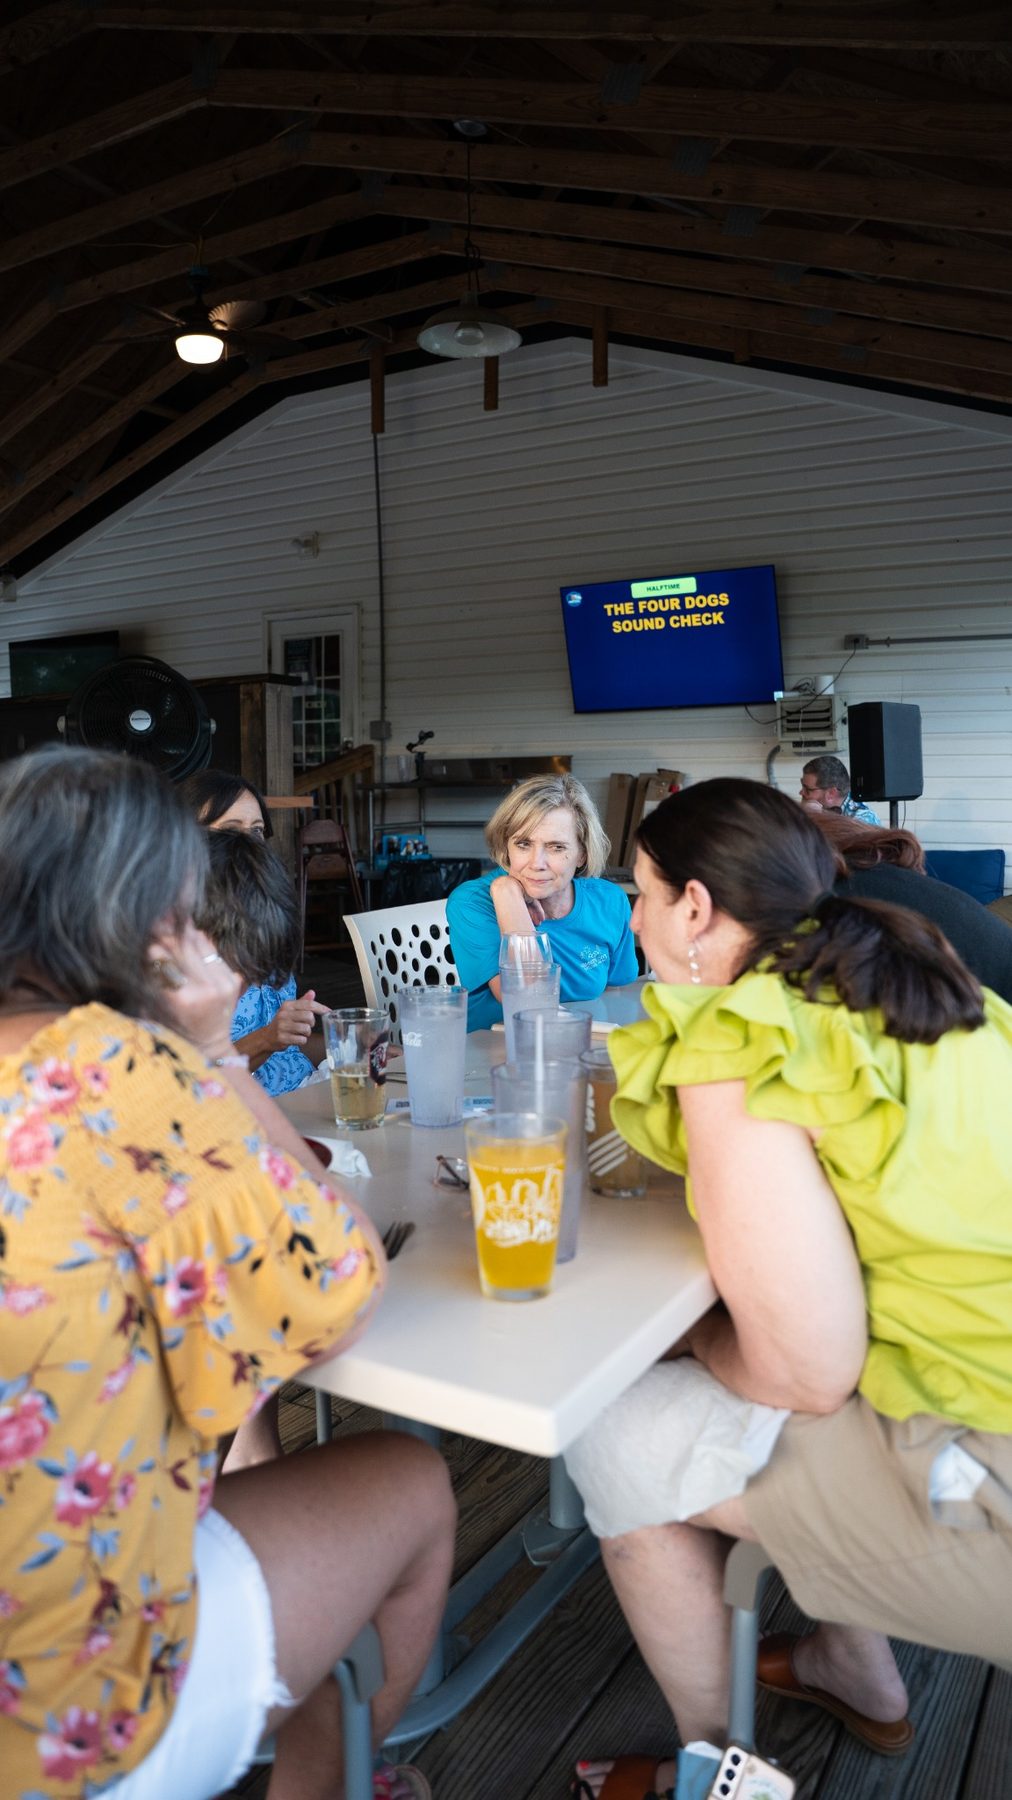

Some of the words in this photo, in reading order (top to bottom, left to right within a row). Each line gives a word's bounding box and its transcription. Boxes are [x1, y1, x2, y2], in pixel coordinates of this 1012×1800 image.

[646, 583, 680, 592] HALFTIME
[604, 602, 634, 616] THE
[638, 598, 681, 613] FOUR
[684, 593, 730, 608] DOGS
[612, 617, 665, 633] SOUND
[669, 612, 724, 628] CHECK
